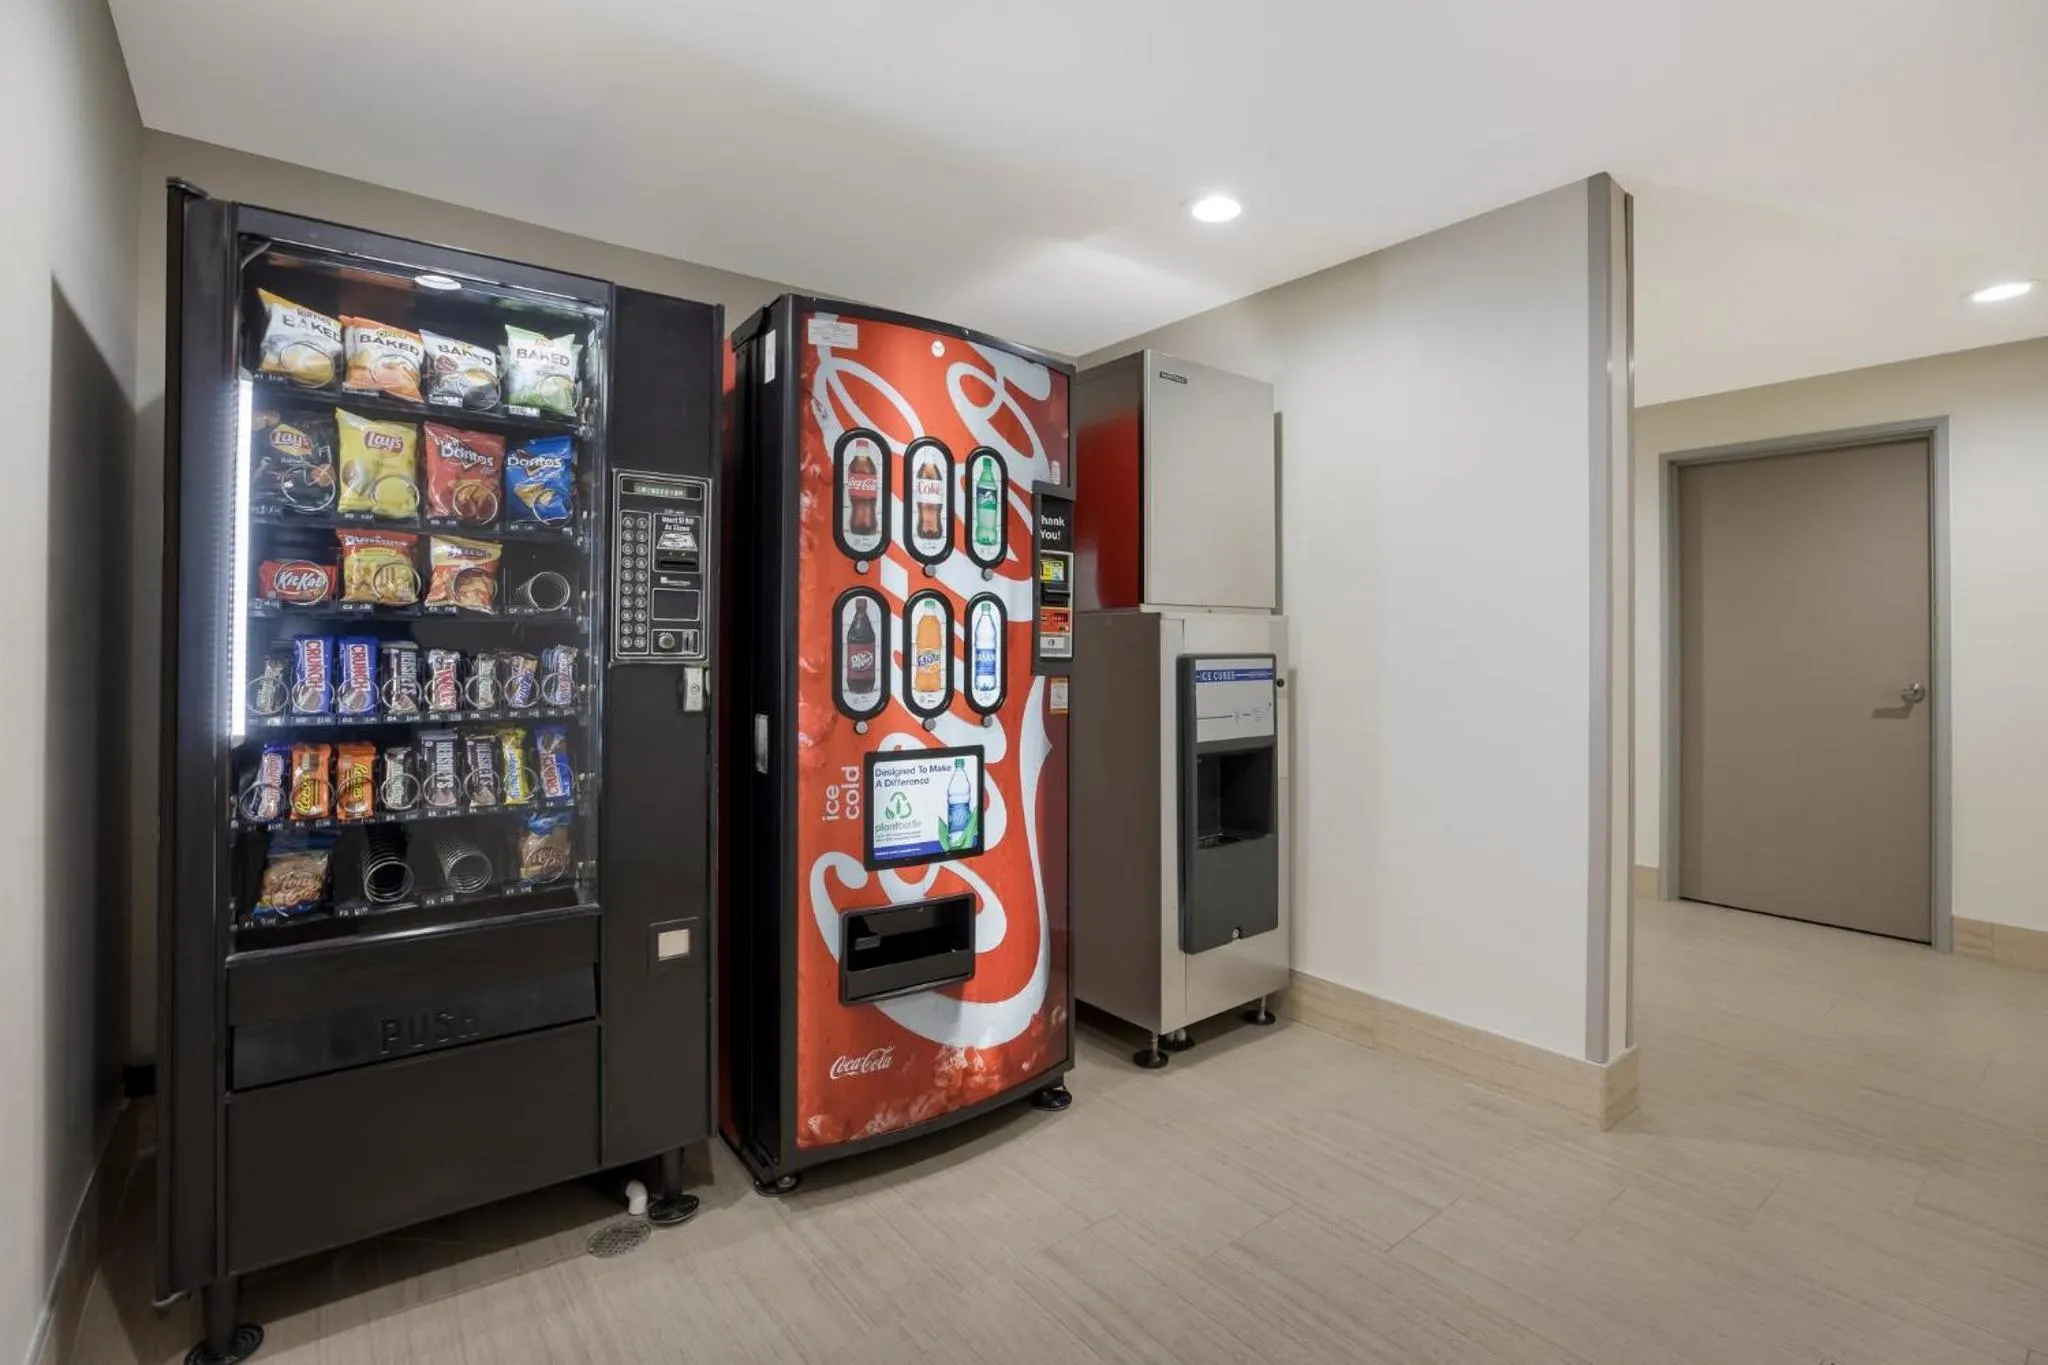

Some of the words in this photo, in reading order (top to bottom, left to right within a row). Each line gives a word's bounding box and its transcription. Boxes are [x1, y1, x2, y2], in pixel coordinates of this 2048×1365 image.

[359, 333, 420, 356] BAKED
[438, 344, 493, 367] BAKED
[516, 348, 570, 367] BAKED
[367, 431, 402, 450] Lay's
[441, 442, 495, 467] Doritos
[507, 455, 563, 469] Doritos
[919, 481, 941, 497] Coke
[1041, 514, 1065, 527] hank
[1040, 530, 1061, 540] You!
[305, 640, 324, 691] CRUNCH
[351, 645, 370, 691] CRUNCH
[436, 741, 454, 789] HERSHEY'S
[875, 765, 916, 779] Designed
[919, 765, 928, 774] To
[929, 764, 951, 773] Make
[841, 766, 860, 819] cold
[875, 780, 883, 788] A
[884, 777, 930, 787] Difference
[822, 785, 841, 821] ice
[829, 1044, 895, 1080] Coca-Cola
